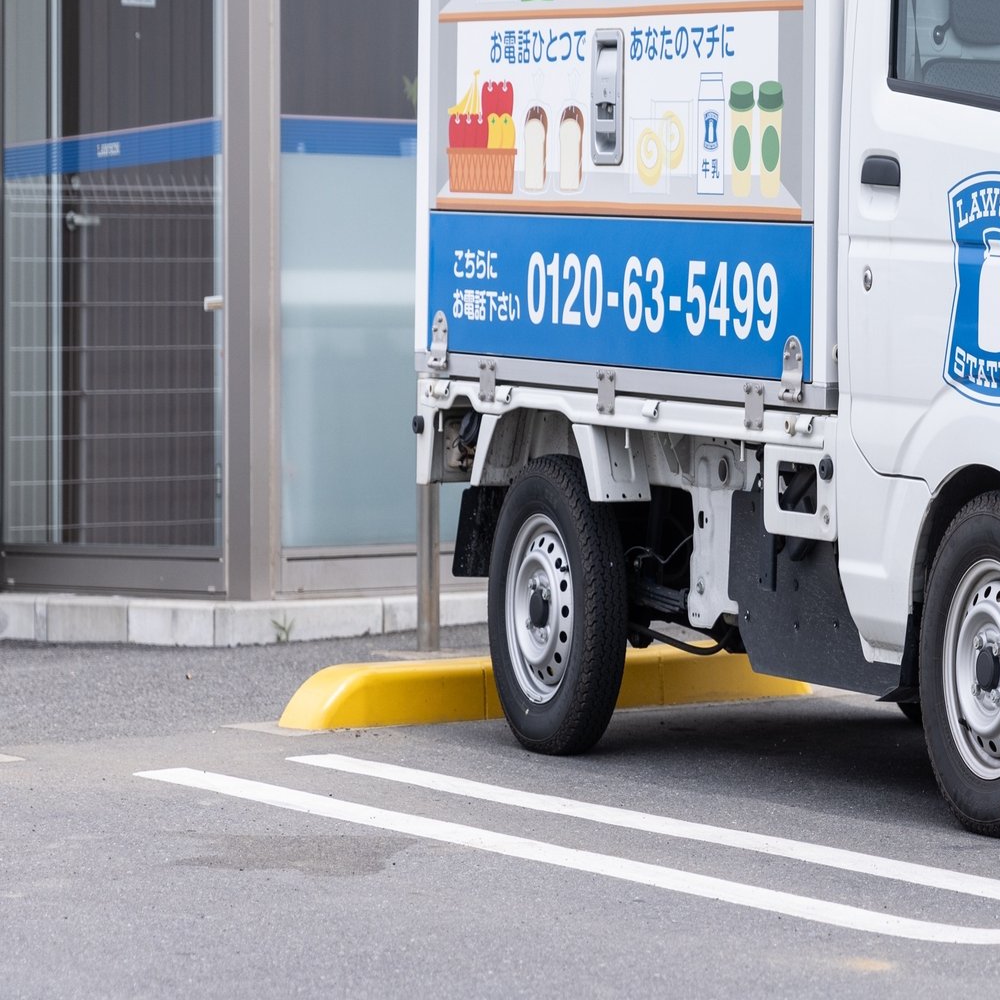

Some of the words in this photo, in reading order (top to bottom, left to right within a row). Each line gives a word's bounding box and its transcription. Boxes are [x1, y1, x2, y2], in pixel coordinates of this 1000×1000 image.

[490, 29, 587, 64] お電話ひとつで
[629, 23, 735, 61] あなたのマチに
[702, 158, 719, 179] 牛乳
[453, 248, 498, 280] こちらに
[452, 288, 521, 322] お電話下さい
[527, 251, 778, 341] 0120-63-5499
